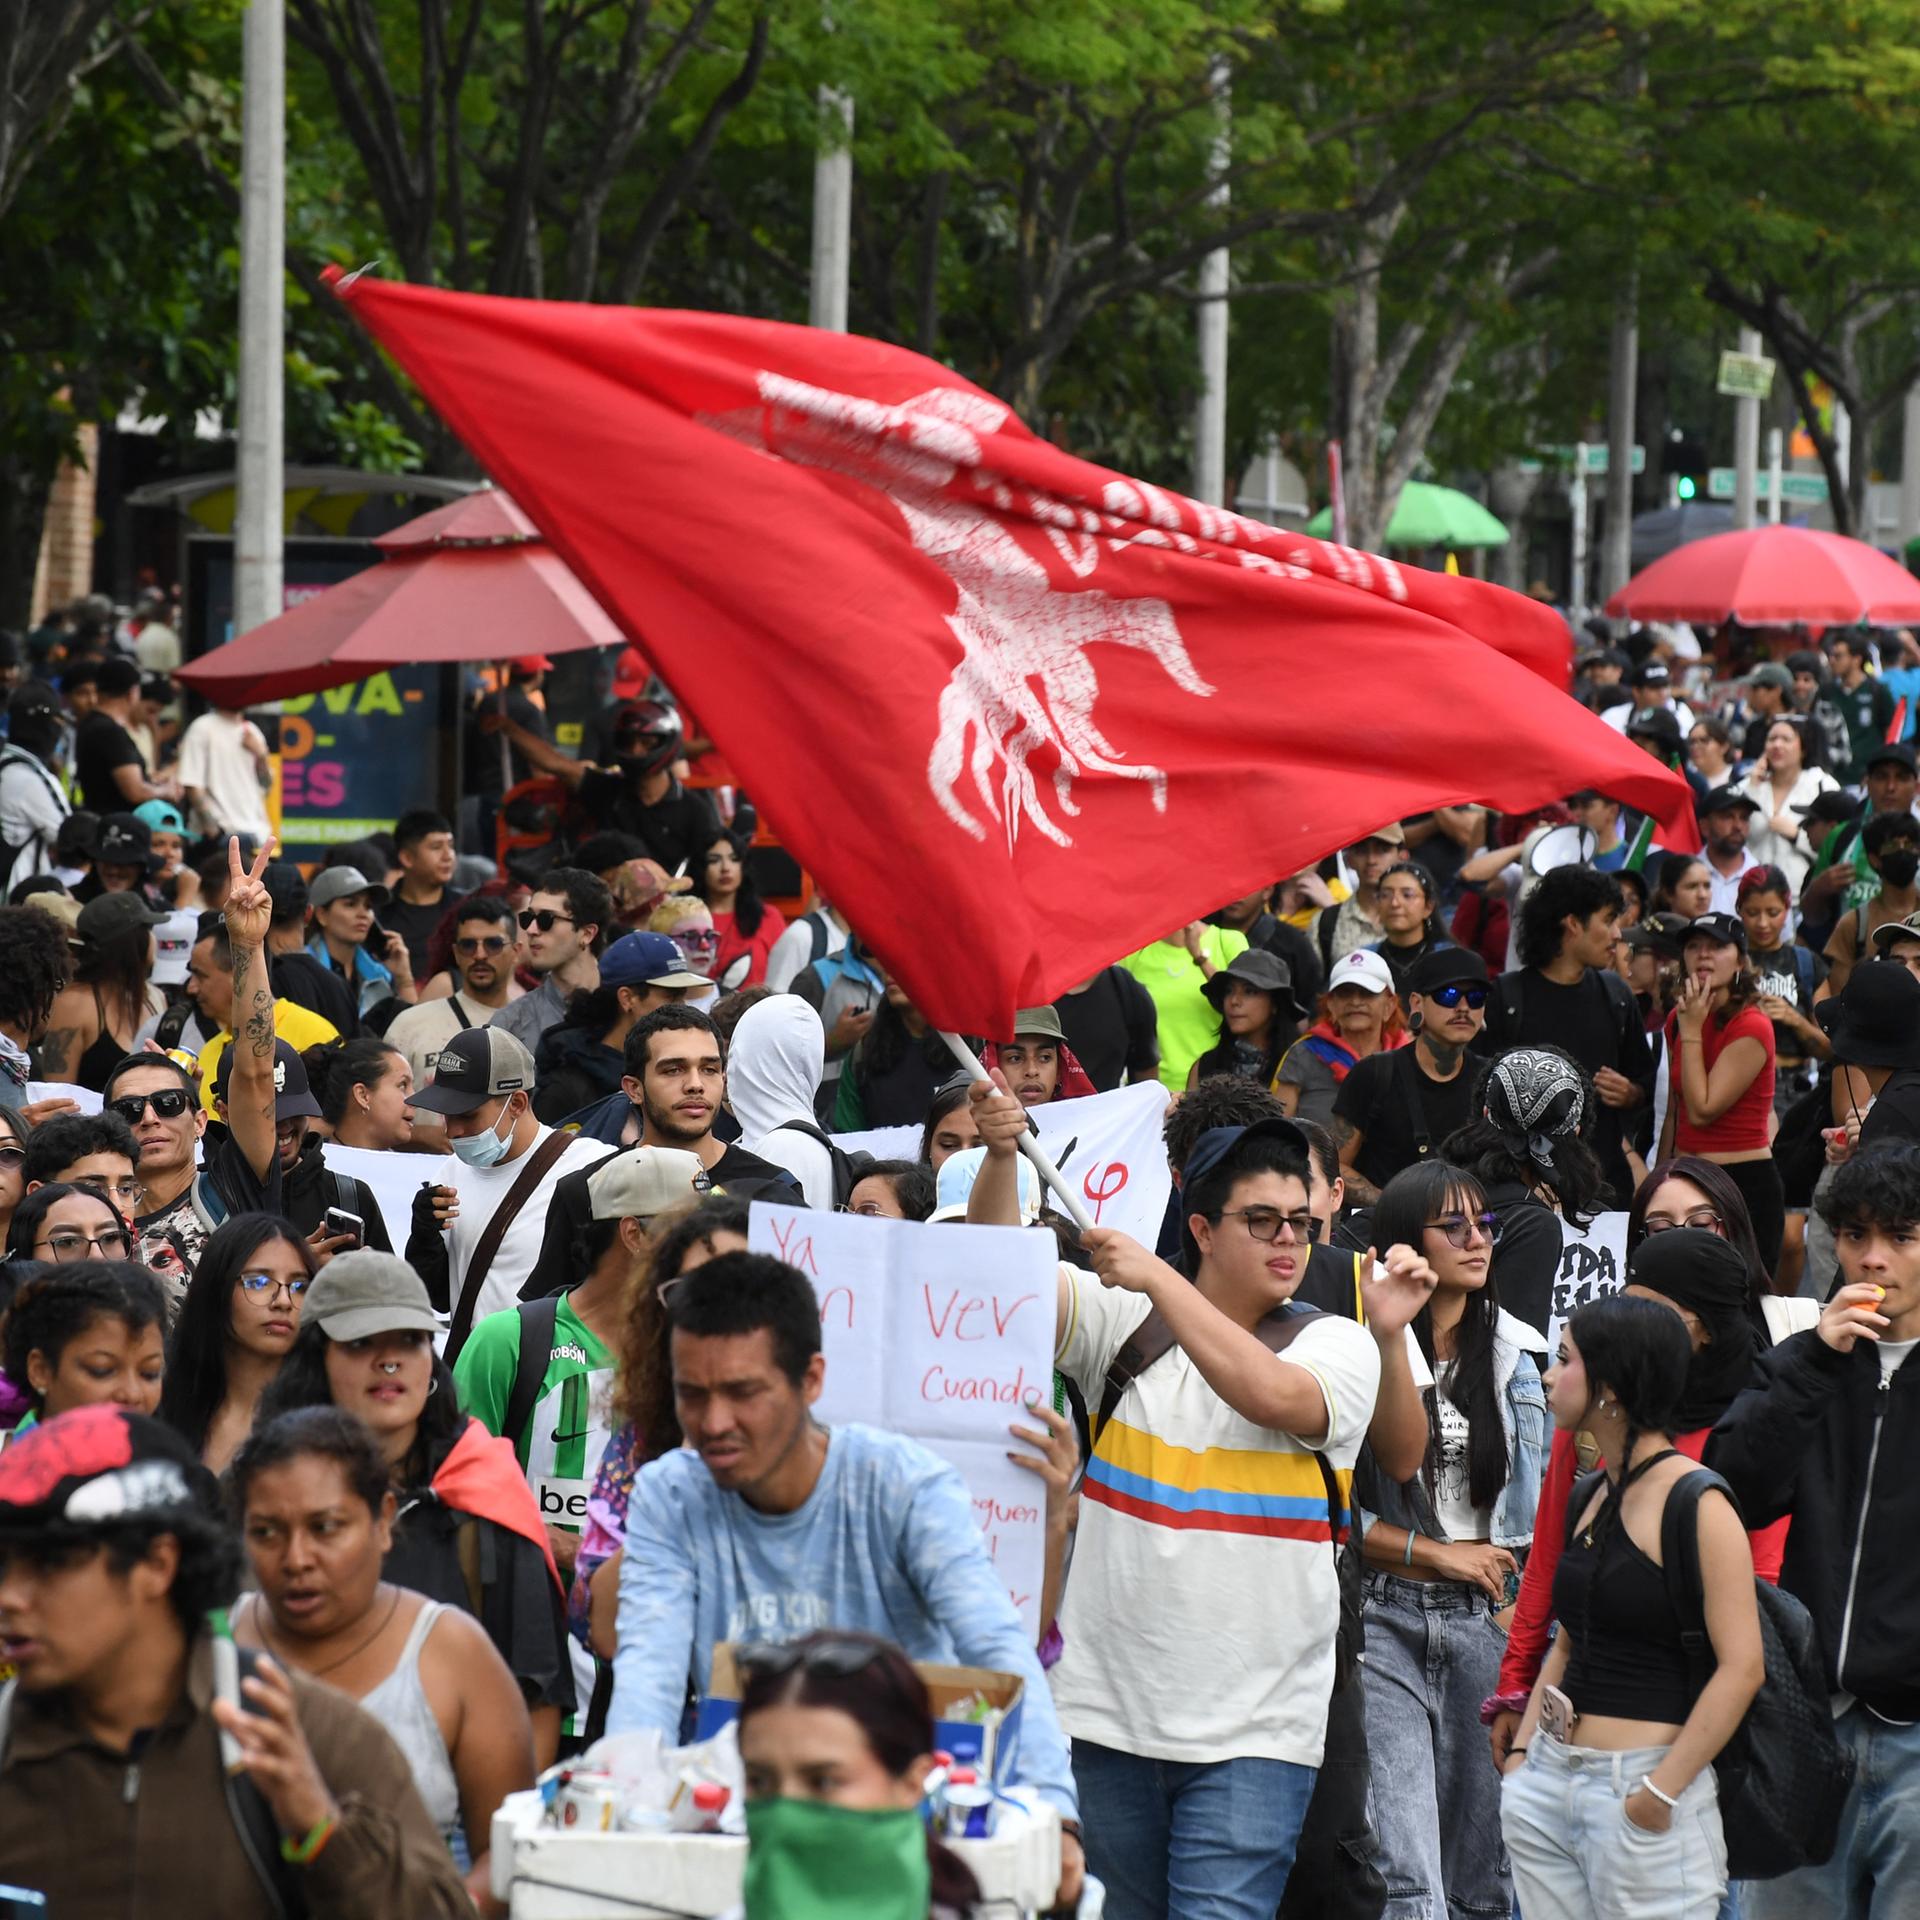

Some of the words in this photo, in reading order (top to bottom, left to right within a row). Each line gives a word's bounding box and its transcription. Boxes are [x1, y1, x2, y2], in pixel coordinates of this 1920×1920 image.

[924, 1283, 1040, 1342] Ver
[920, 1365, 1044, 1408] Cuando
[540, 1484, 587, 1517] be
